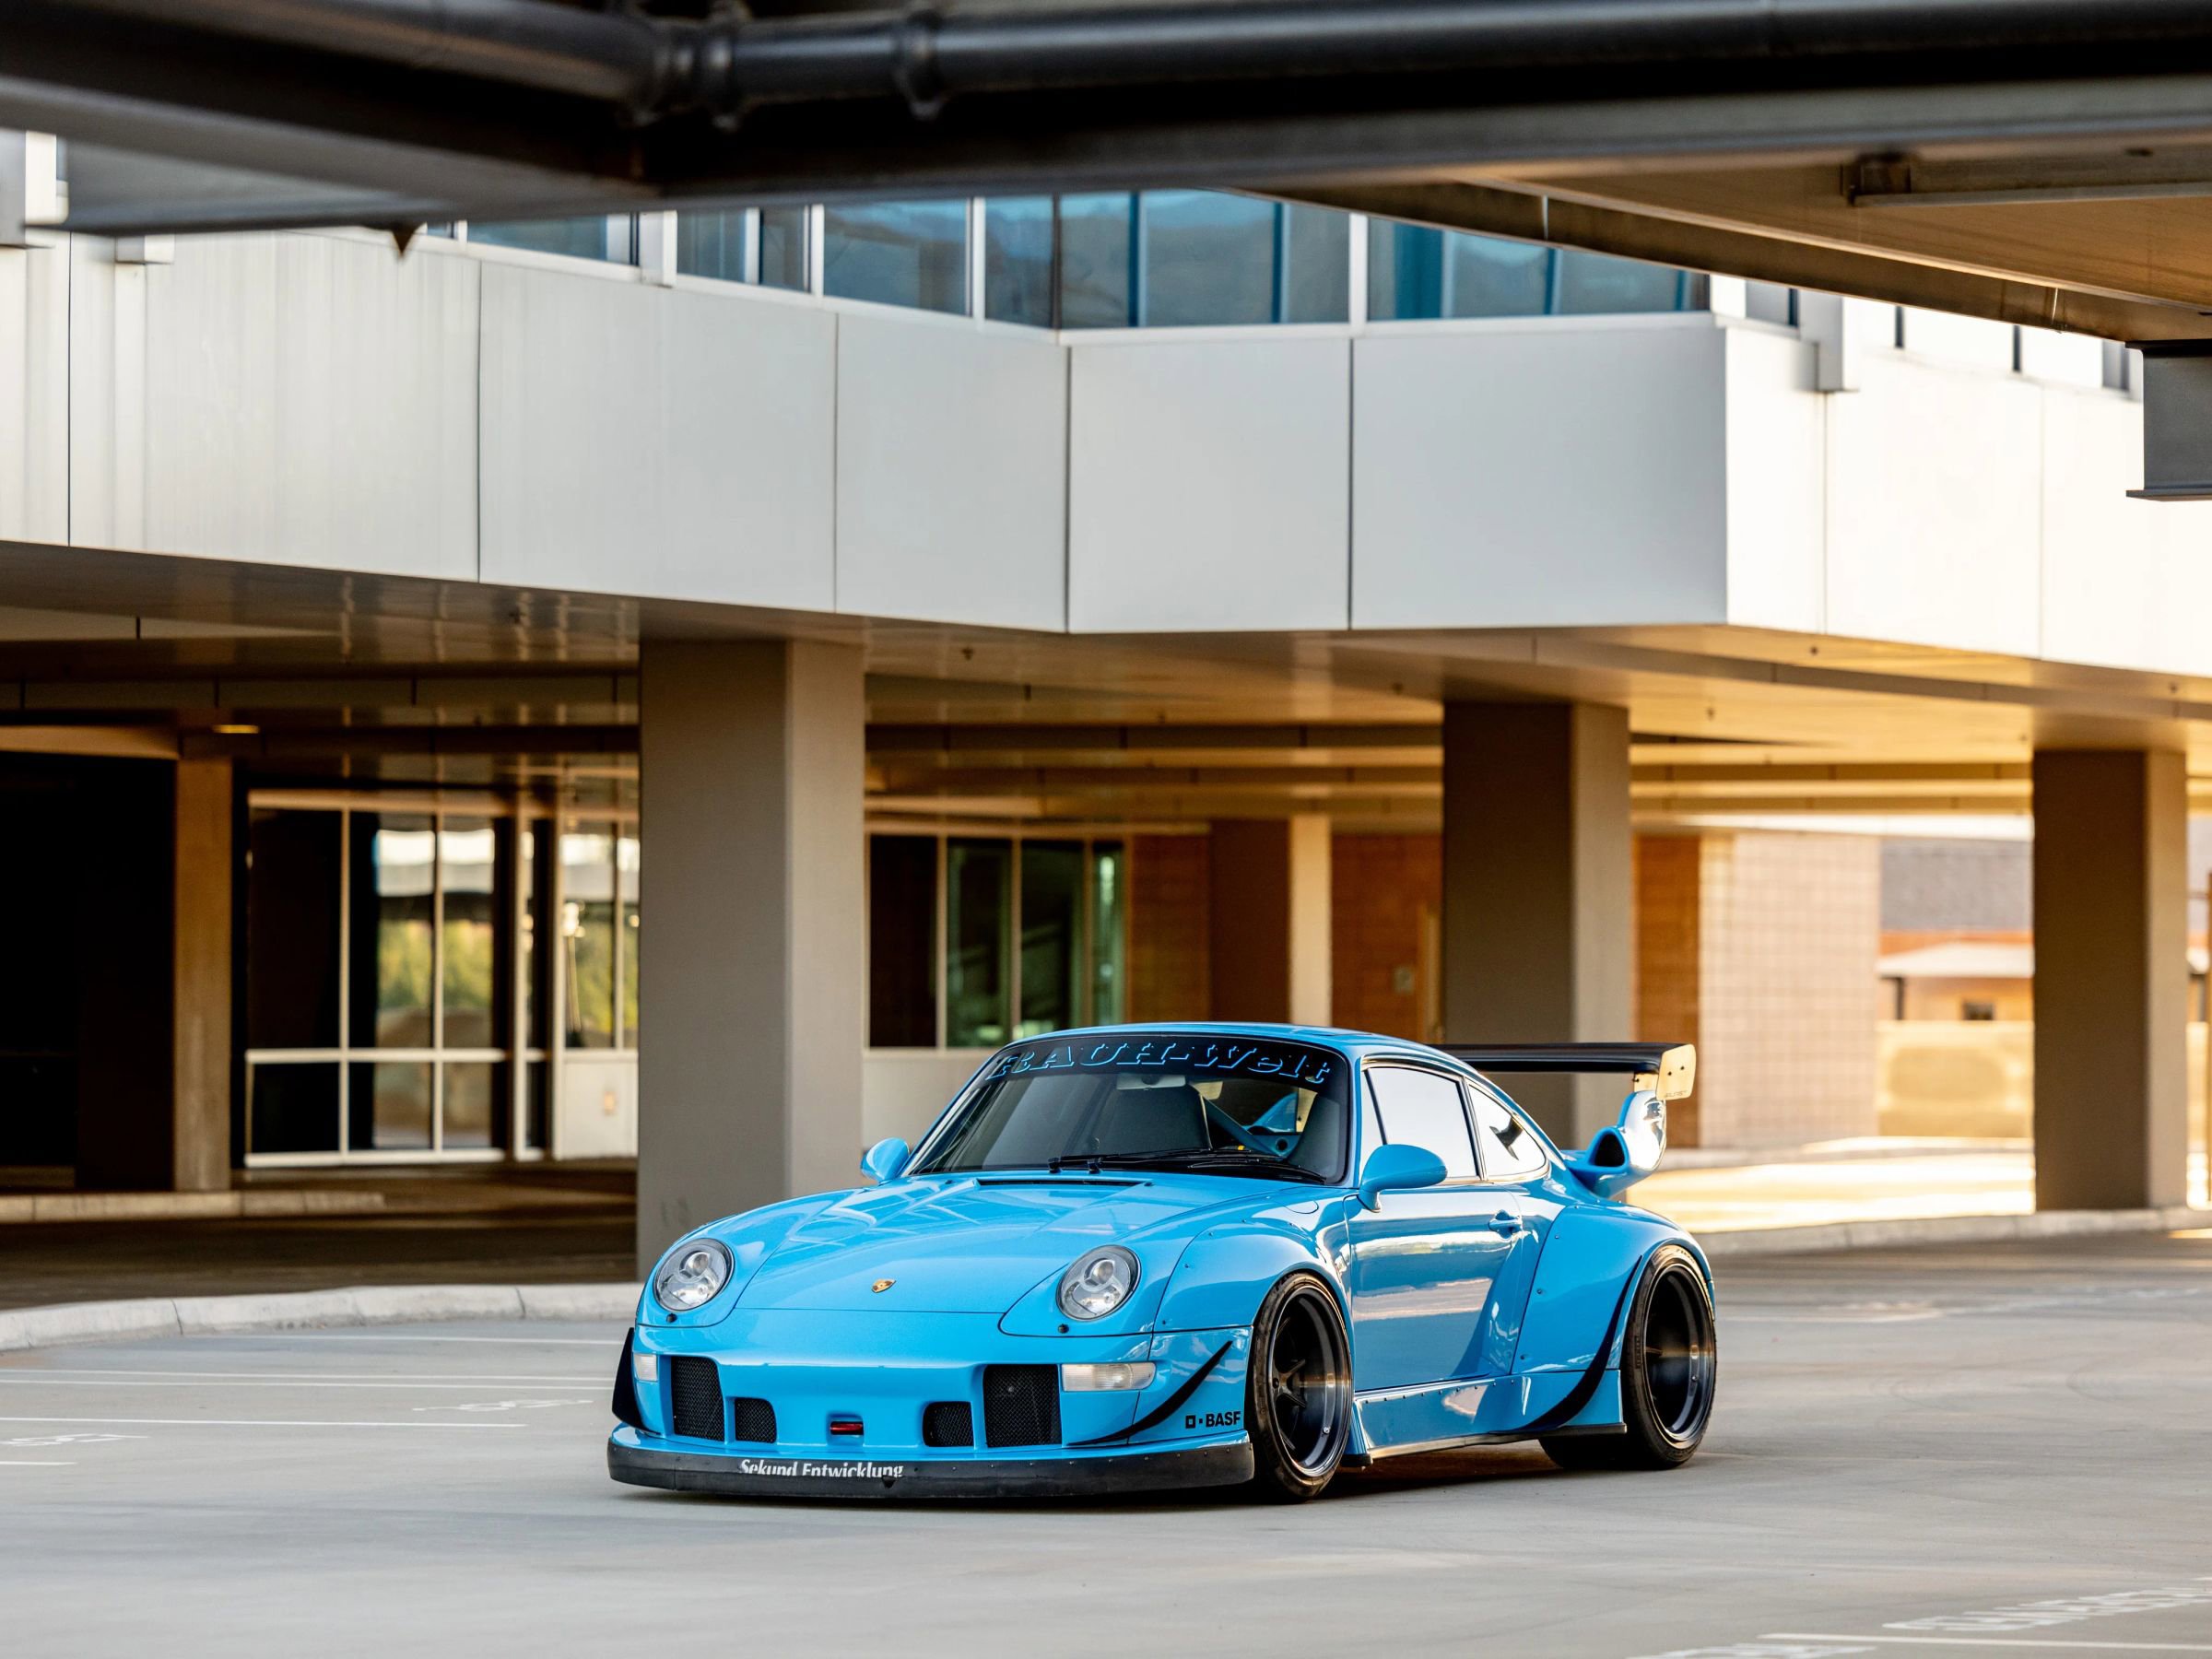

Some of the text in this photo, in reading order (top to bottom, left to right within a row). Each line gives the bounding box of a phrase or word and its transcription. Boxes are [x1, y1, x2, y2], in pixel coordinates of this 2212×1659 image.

[1206, 1410, 1241, 1428] BASF
[740, 1458, 904, 1478] Sekund Entwicklung
